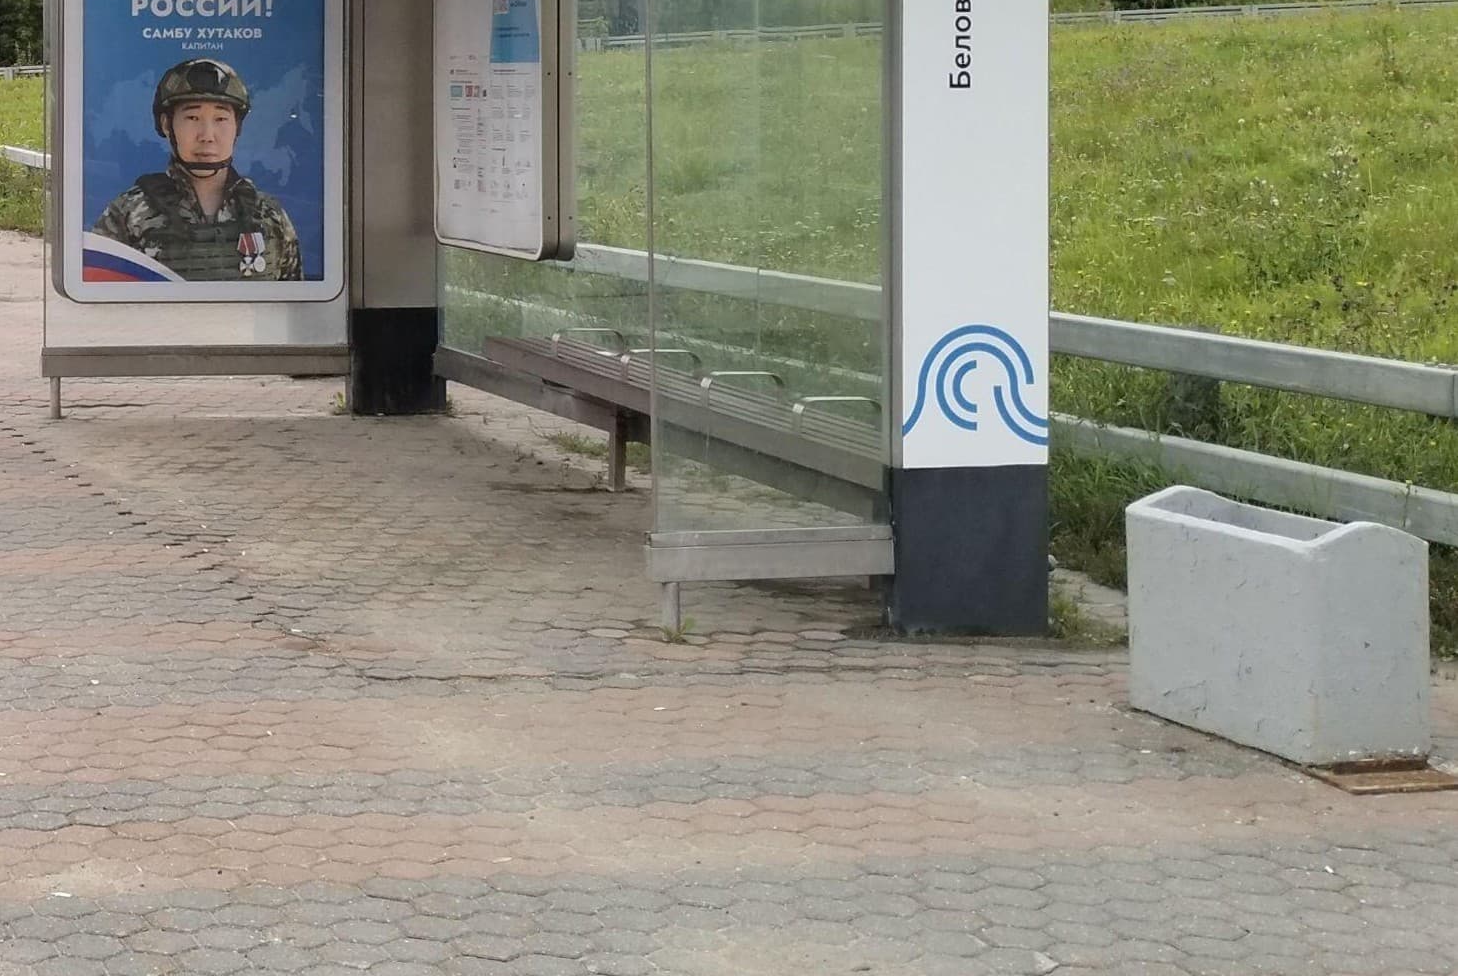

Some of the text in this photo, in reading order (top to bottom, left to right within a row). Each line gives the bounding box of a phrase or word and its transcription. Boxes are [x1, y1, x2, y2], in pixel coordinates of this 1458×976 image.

[142, 27, 262, 39] САМБУ ХУТАКОВ
[181, 41, 223, 50] КАПИТАН
